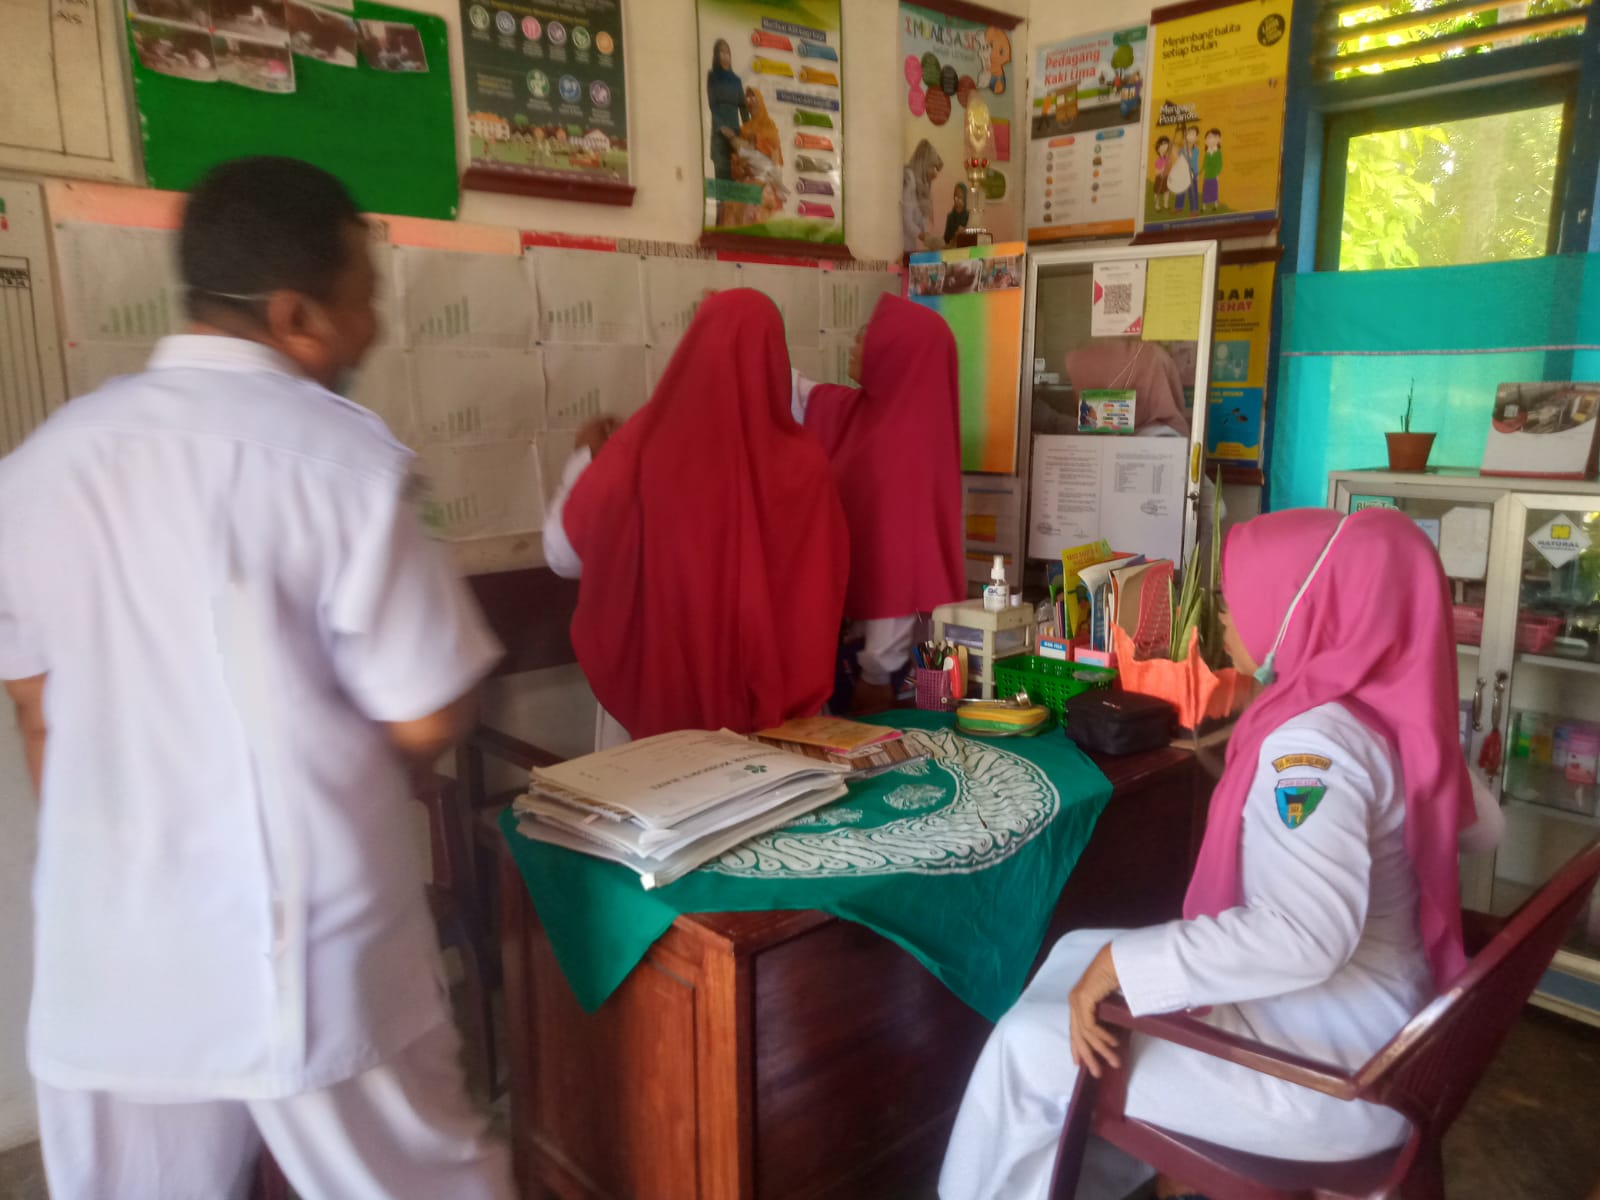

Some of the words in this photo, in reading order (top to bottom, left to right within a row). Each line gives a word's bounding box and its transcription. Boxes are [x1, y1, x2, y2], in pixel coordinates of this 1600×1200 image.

[1162, 28, 1213, 48] Menimbang
[1214, 23, 1242, 37] balita
[1162, 45, 1189, 59] setiap
[1190, 40, 1218, 54] bulan
[1046, 50, 1101, 69] Pedagang
[1045, 73, 1067, 86] Kaki
